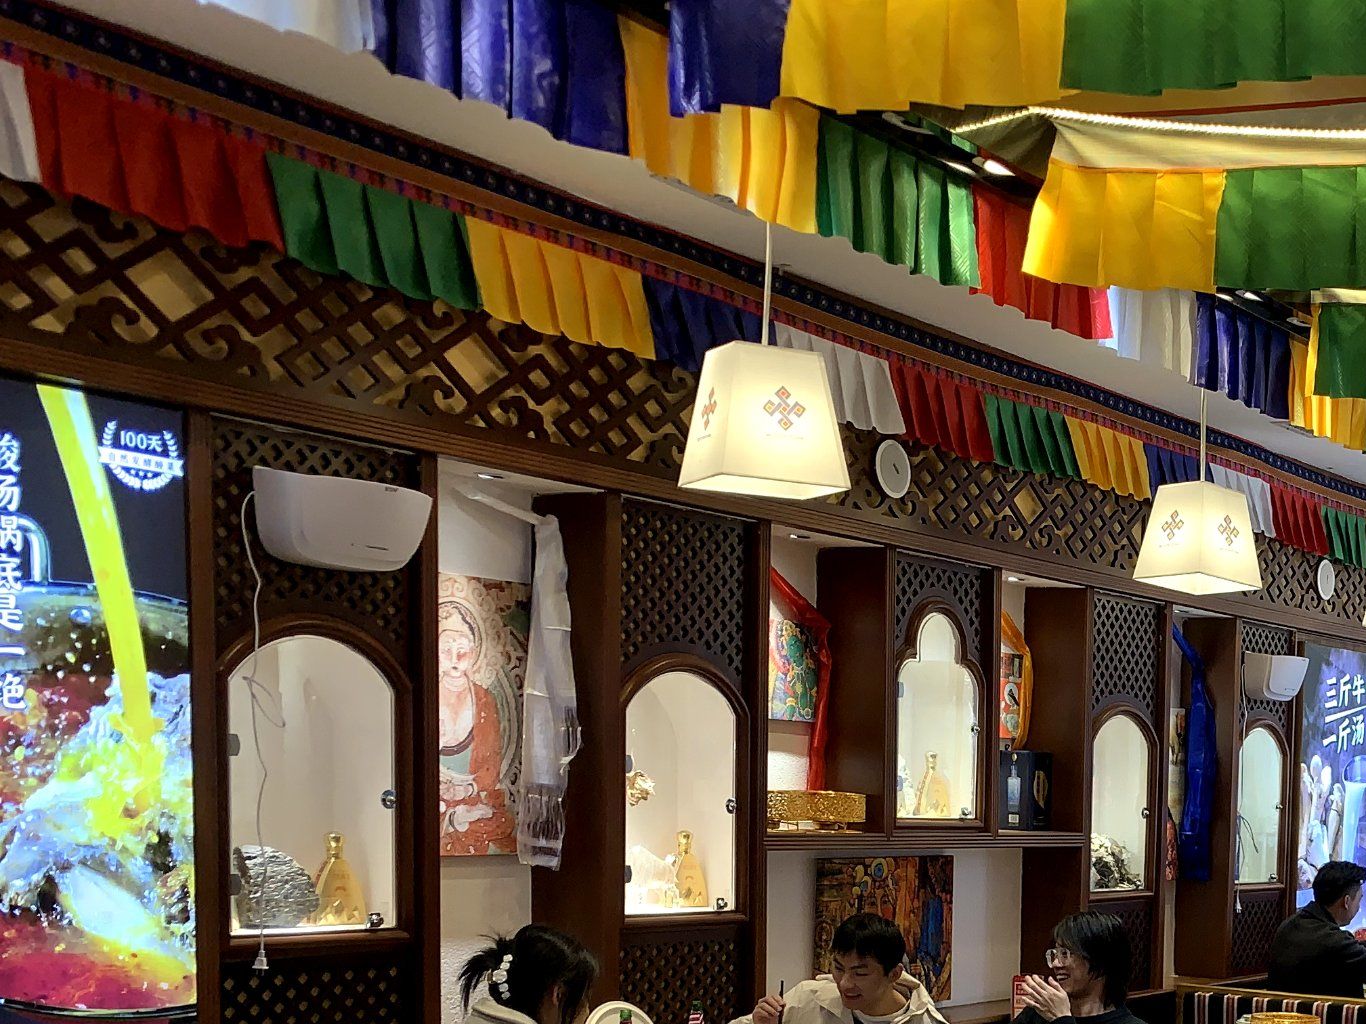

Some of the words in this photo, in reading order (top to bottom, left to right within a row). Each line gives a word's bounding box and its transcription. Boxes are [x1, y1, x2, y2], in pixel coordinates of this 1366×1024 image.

[121, 430, 163, 452] 100天
[1322, 714, 1366, 754] 一斤汤
